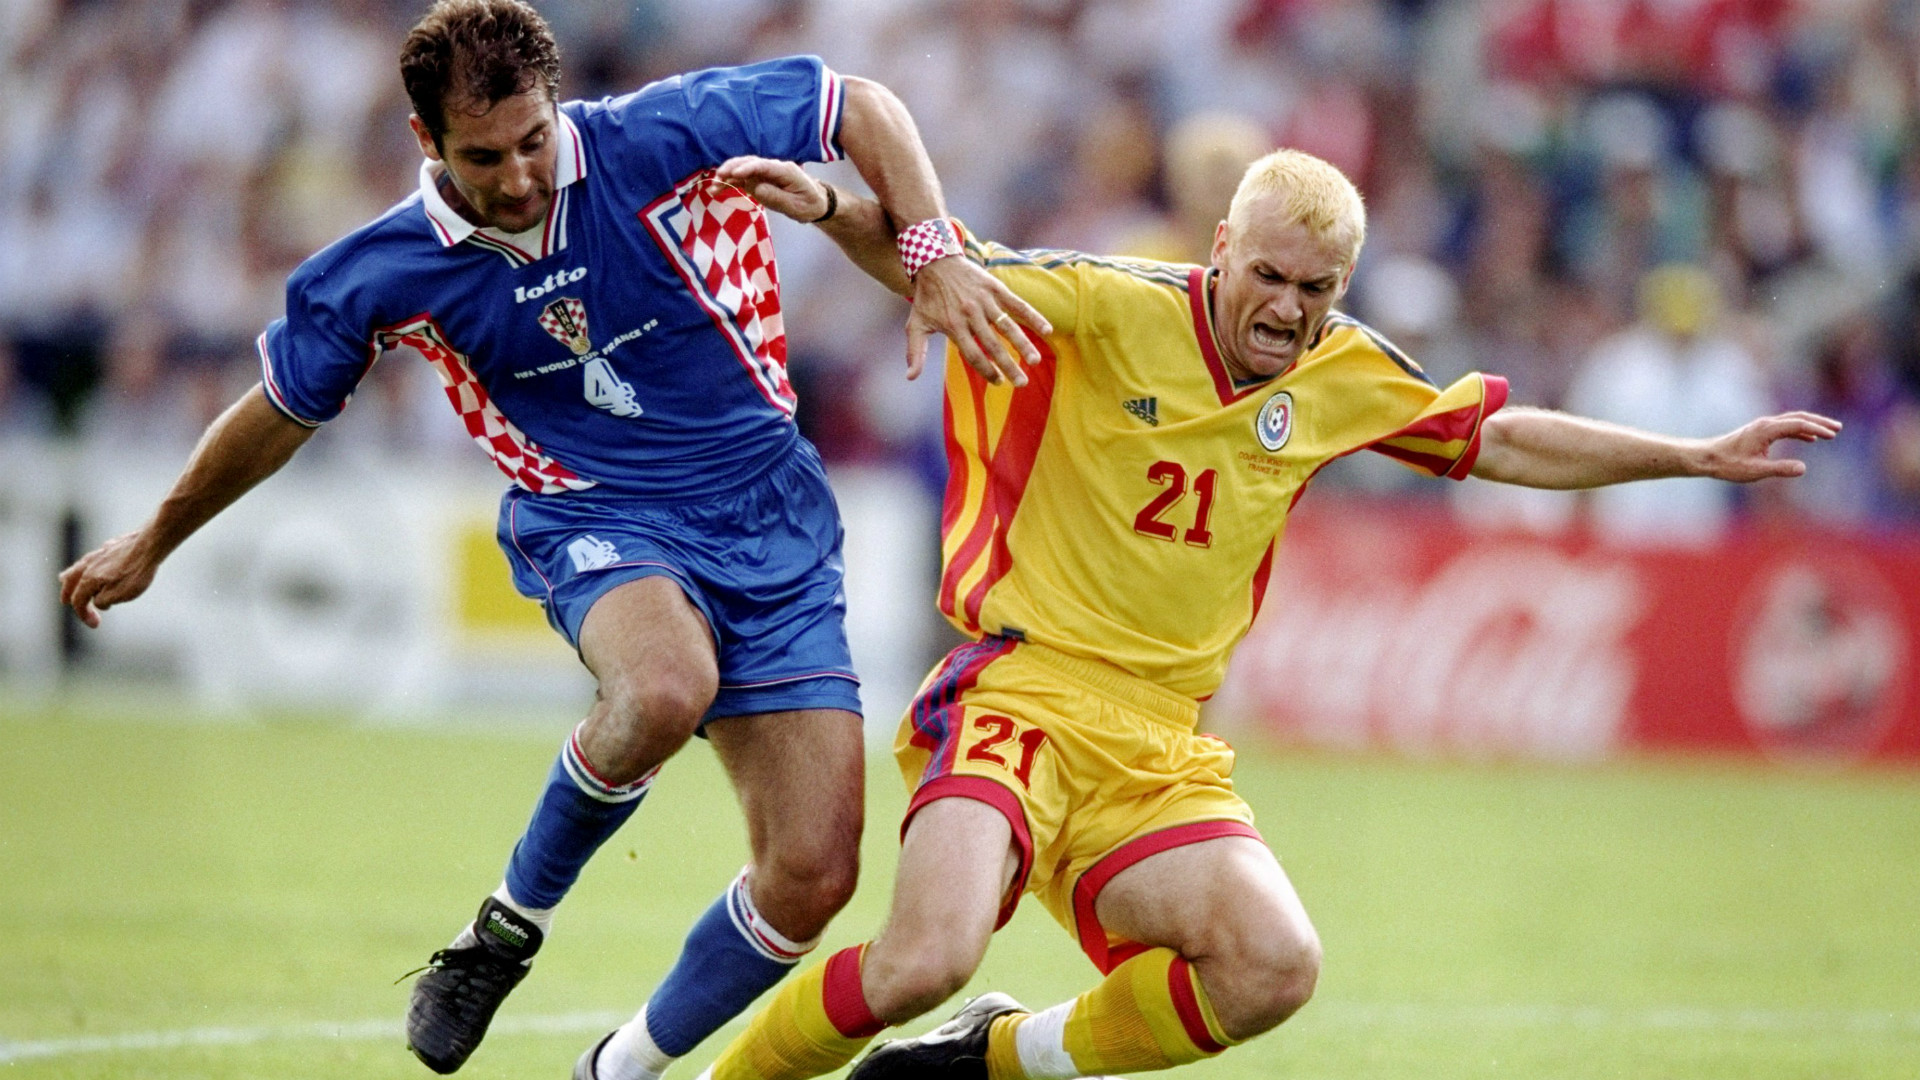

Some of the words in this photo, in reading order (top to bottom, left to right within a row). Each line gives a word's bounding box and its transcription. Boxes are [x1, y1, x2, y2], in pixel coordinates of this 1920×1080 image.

[514, 267, 587, 303] lotto
[555, 305, 575, 333] HNS
[514, 370, 537, 379] FIFA
[537, 359, 577, 374] WORLD
[578, 351, 599, 363] CUP
[602, 329, 642, 355] FRANCE
[584, 357, 643, 418] 4
[1122, 400, 1159, 427] adidas
[1134, 460, 1219, 549] 21
[966, 714, 1049, 796] 21
[499, 917, 529, 939] lotto
